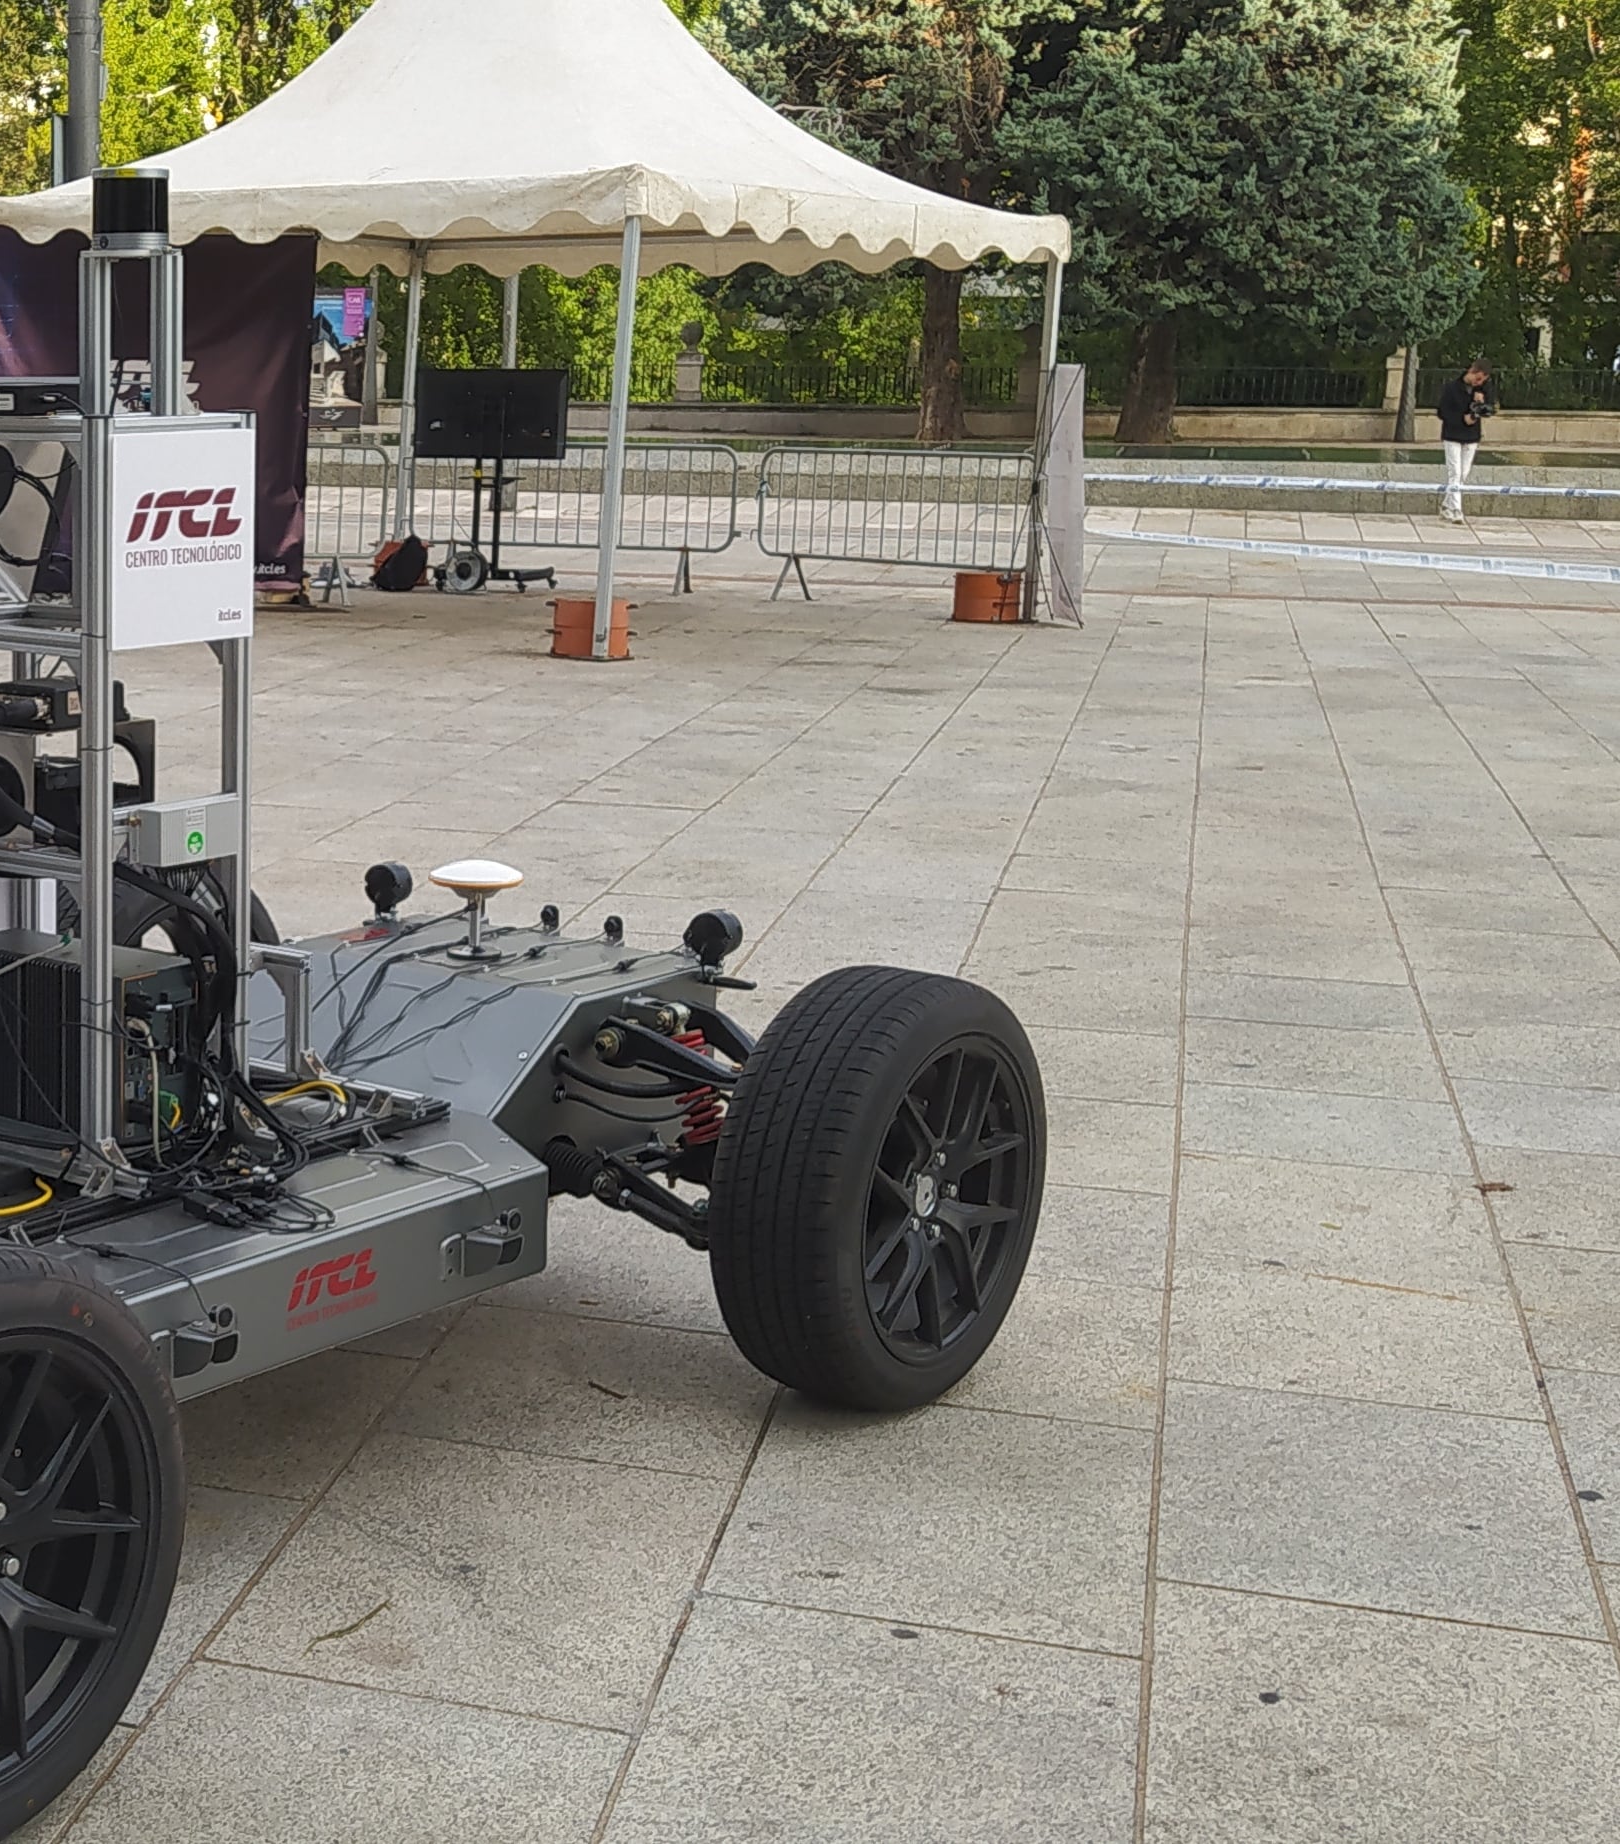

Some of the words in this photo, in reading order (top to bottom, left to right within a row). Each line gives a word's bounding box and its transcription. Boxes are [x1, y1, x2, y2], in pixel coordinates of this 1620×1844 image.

[126, 487, 242, 543] ITCL
[125, 545, 168, 568] CENTRO
[171, 540, 242, 565] TECNOLÓGICO
[287, 1248, 378, 1312] ITCL
